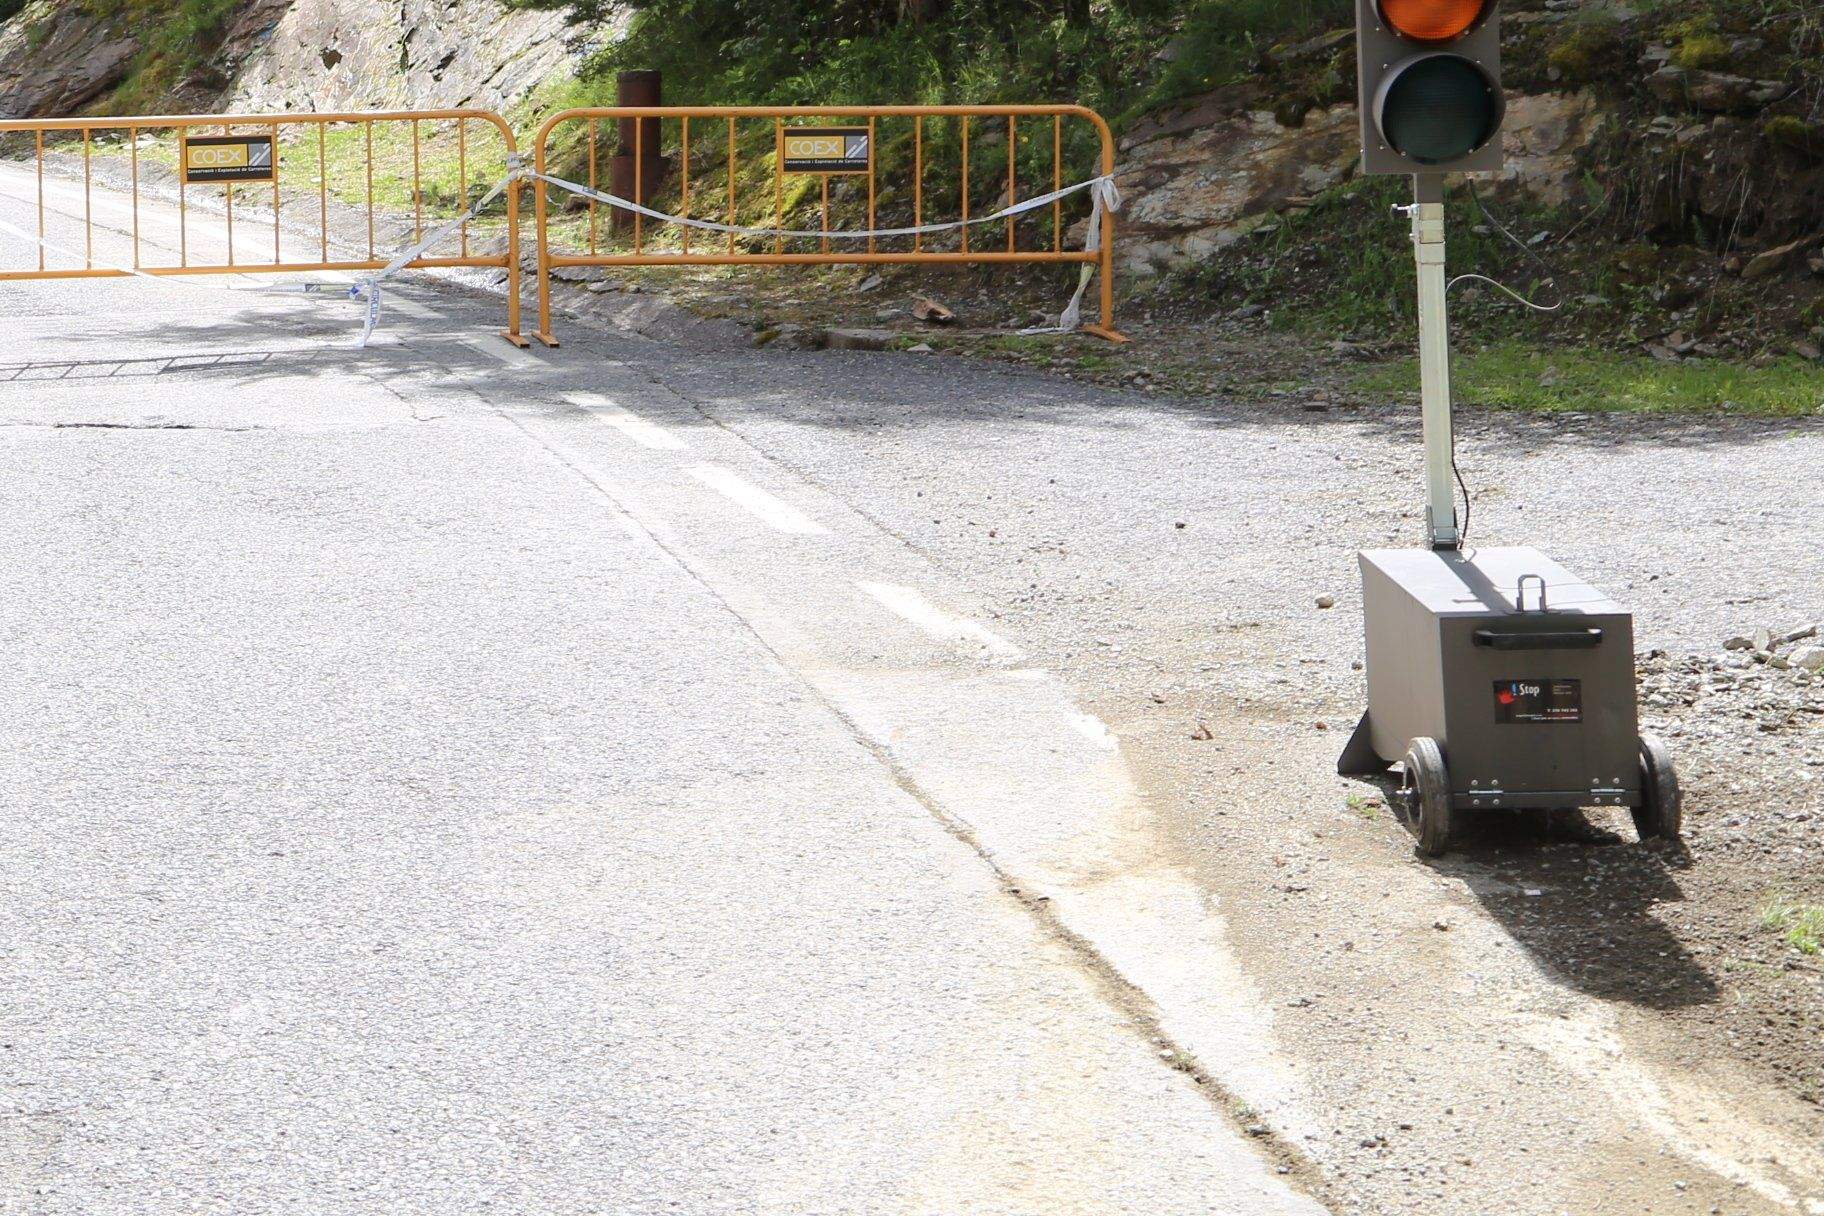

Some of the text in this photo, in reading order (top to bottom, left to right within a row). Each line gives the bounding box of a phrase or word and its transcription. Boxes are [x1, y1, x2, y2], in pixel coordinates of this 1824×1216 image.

[790, 140, 839, 155] COEX
[192, 149, 240, 163] COEX
[1519, 683, 1540, 697] Stop
